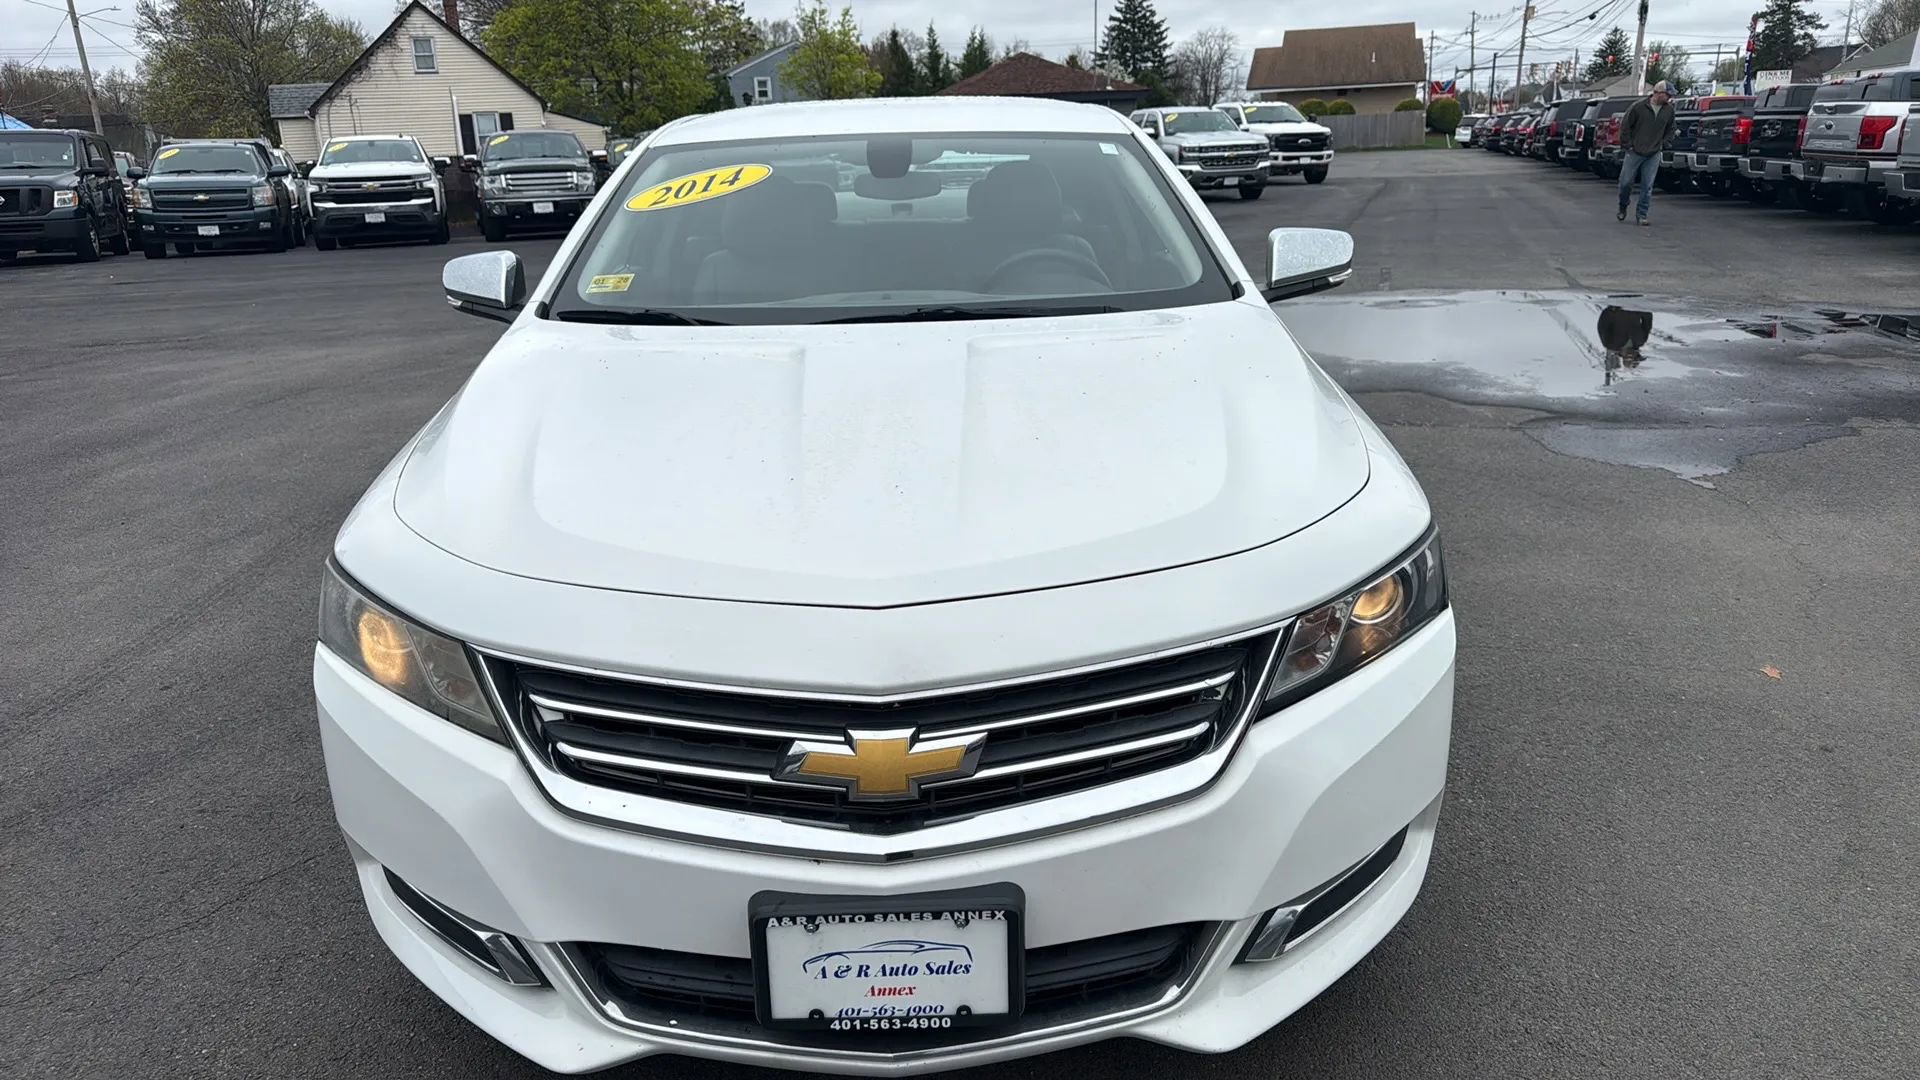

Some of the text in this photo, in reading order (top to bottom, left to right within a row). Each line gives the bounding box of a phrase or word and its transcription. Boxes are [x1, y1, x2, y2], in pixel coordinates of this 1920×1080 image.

[648, 166, 745, 208] 2014
[767, 910, 1006, 928] A&R AUTO SALES ANNEX
[814, 960, 972, 979] A & R Auto Sales
[864, 984, 917, 997] Annex
[830, 1017, 951, 1031] 401-563-4900
